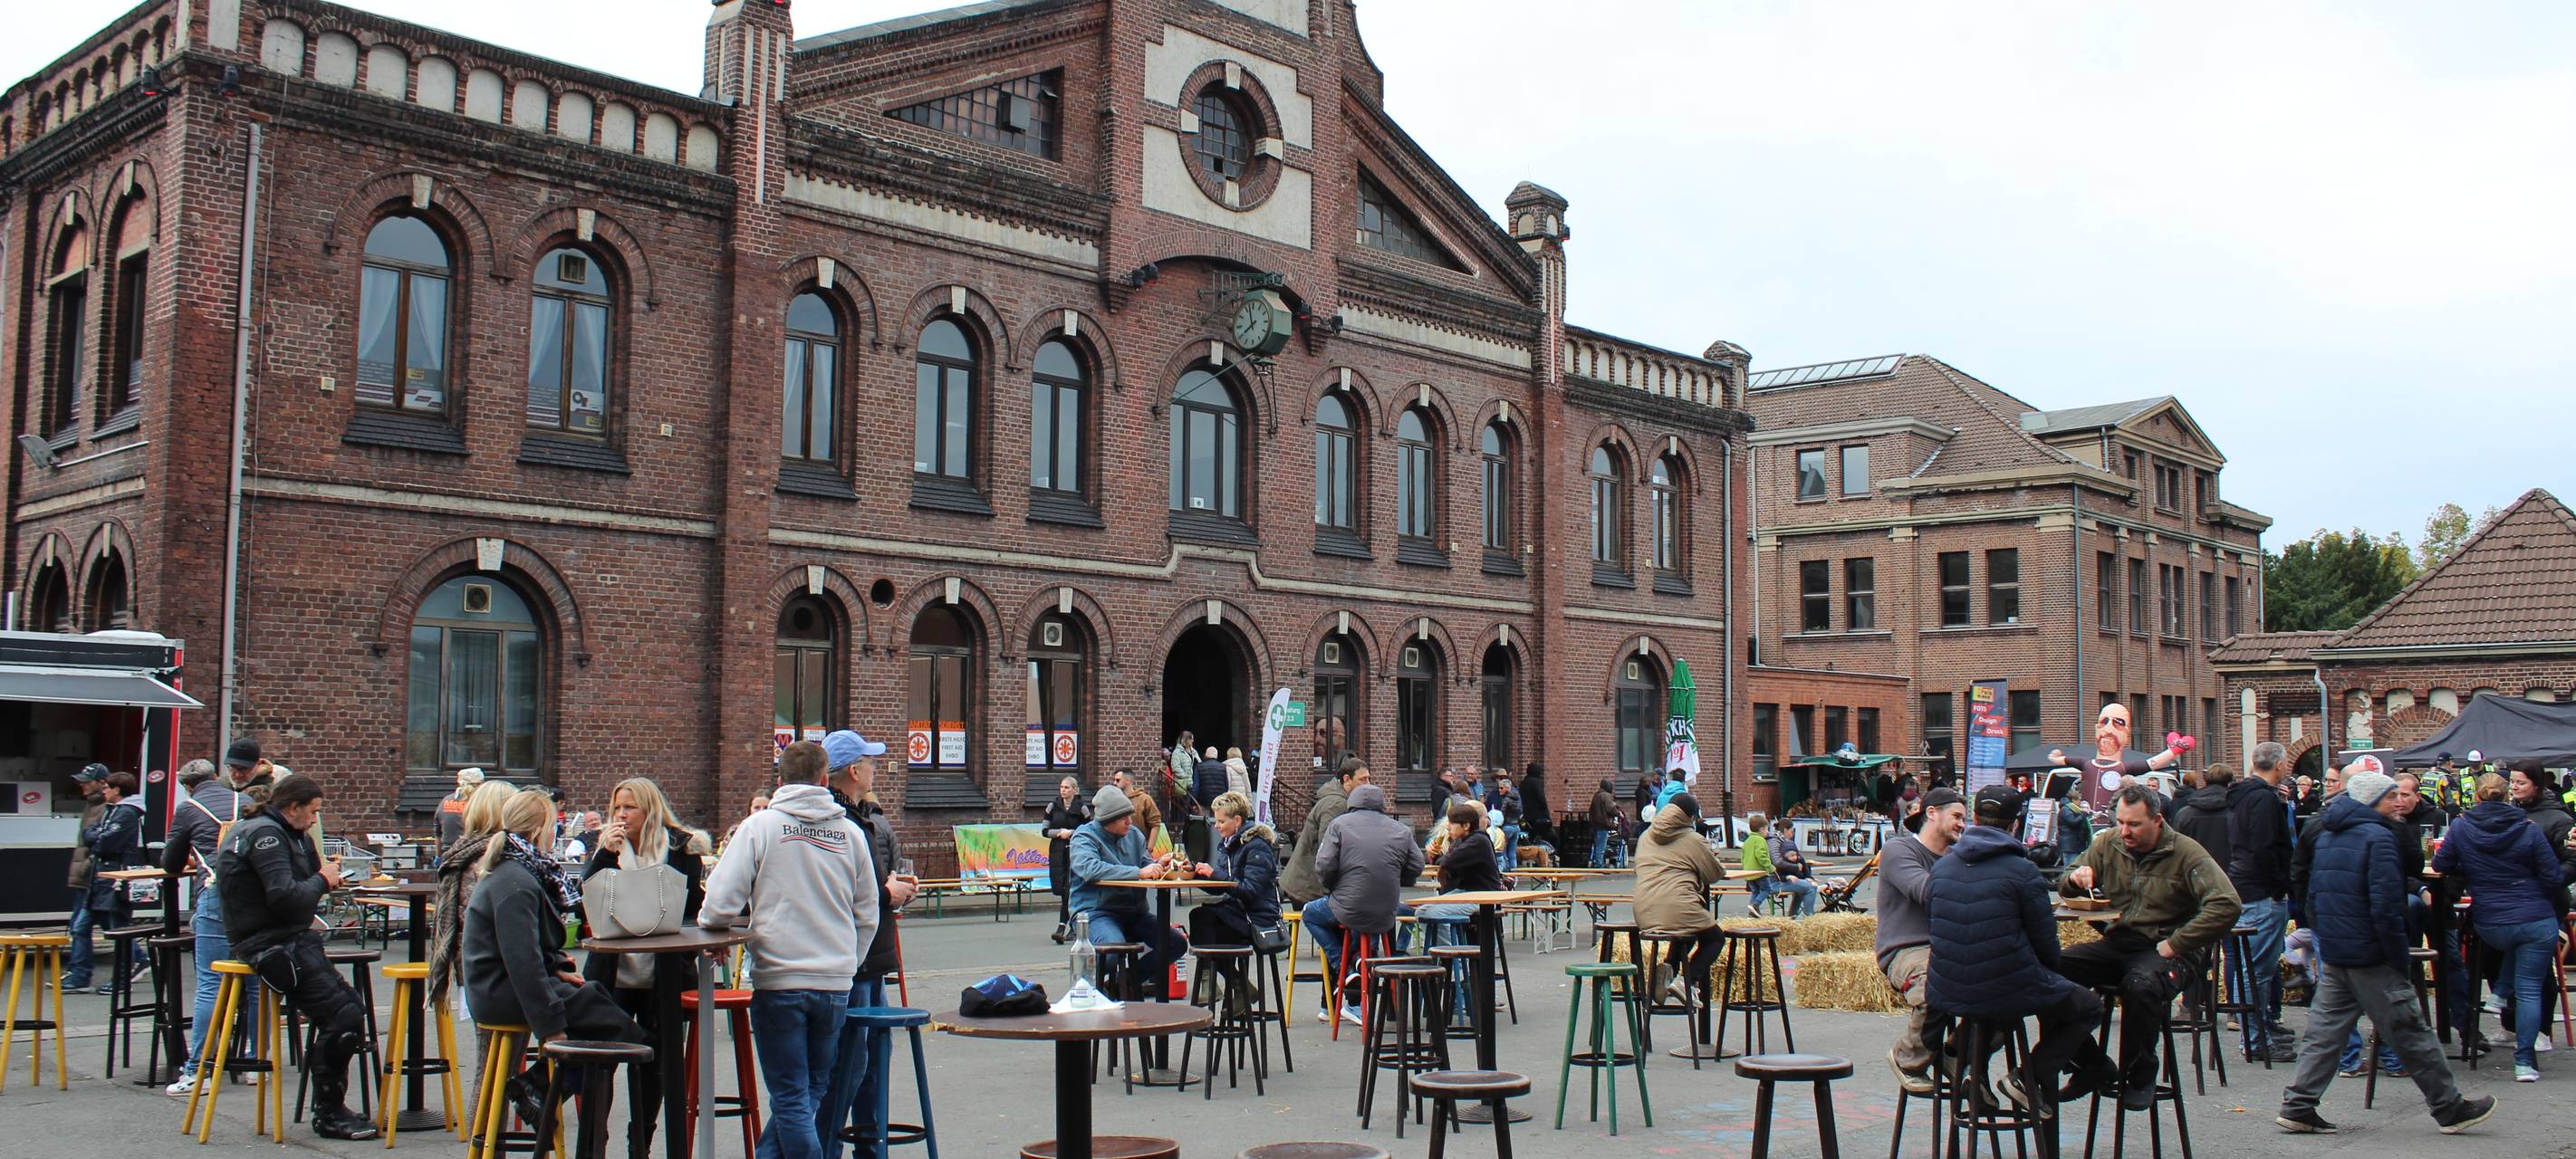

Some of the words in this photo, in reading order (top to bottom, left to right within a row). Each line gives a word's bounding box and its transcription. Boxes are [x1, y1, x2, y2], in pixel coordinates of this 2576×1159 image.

[1265, 741, 1274, 763] aid
[1262, 767, 1271, 794] first
[783, 824, 846, 841] Balenciaga
